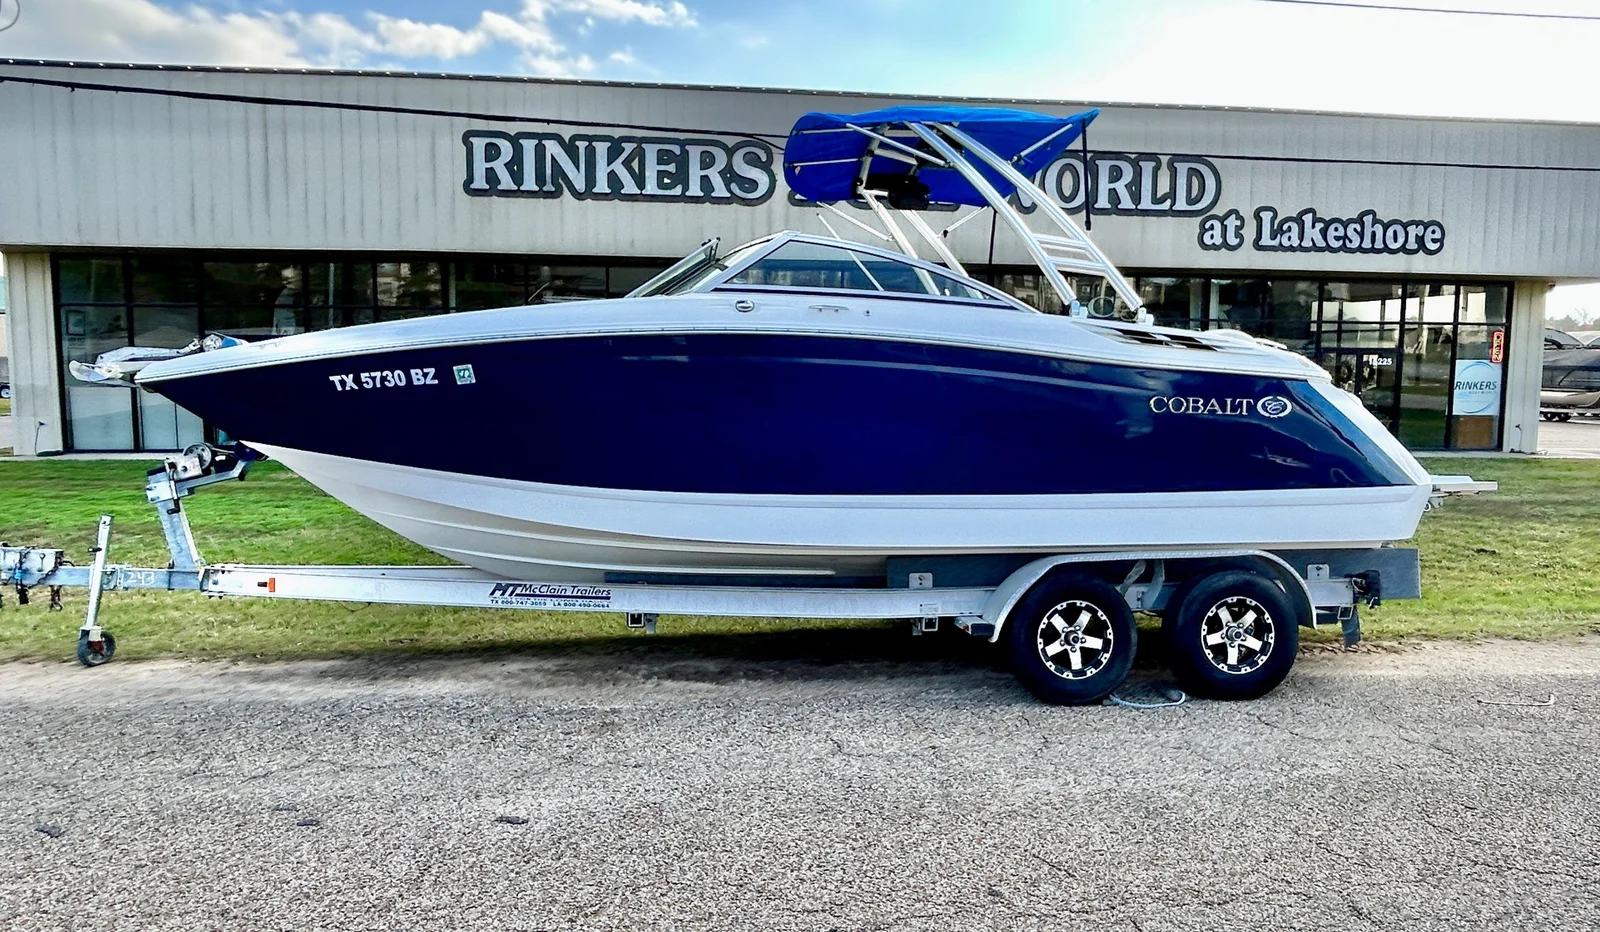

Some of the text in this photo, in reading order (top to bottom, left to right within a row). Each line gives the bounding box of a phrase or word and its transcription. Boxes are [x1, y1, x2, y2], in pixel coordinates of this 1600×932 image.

[467, 135, 771, 200] RINKERS
[1202, 210, 1443, 251] at Lakeshore
[329, 374, 359, 391] TX
[360, 370, 406, 389] 5730
[410, 368, 438, 385] BZ
[1455, 380, 1497, 390] RINKERS
[1150, 396, 1254, 415] COBALT
[520, 584, 567, 594] McClain
[571, 585, 611, 596] Trailers
